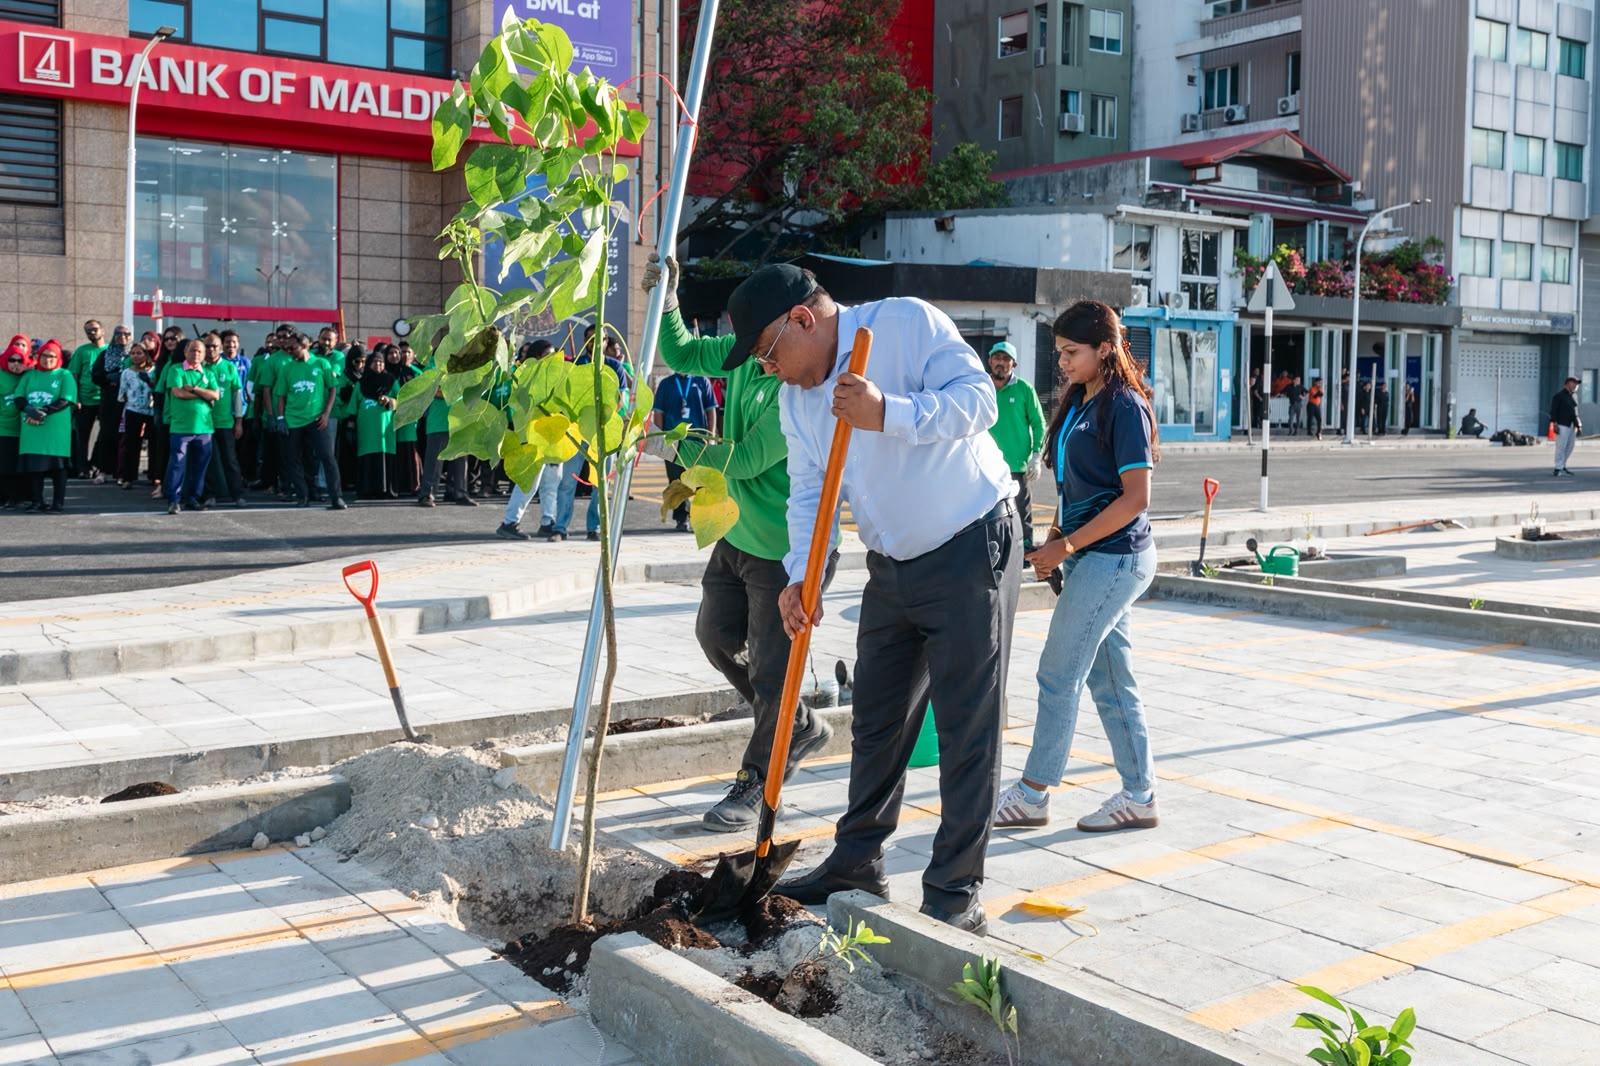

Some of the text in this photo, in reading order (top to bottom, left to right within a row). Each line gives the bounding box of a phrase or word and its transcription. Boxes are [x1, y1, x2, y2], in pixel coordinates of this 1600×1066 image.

[577, 0, 600, 19] at
[581, 51, 613, 63] App Store
[91, 48, 229, 98] BANK
[239, 66, 296, 104] OF
